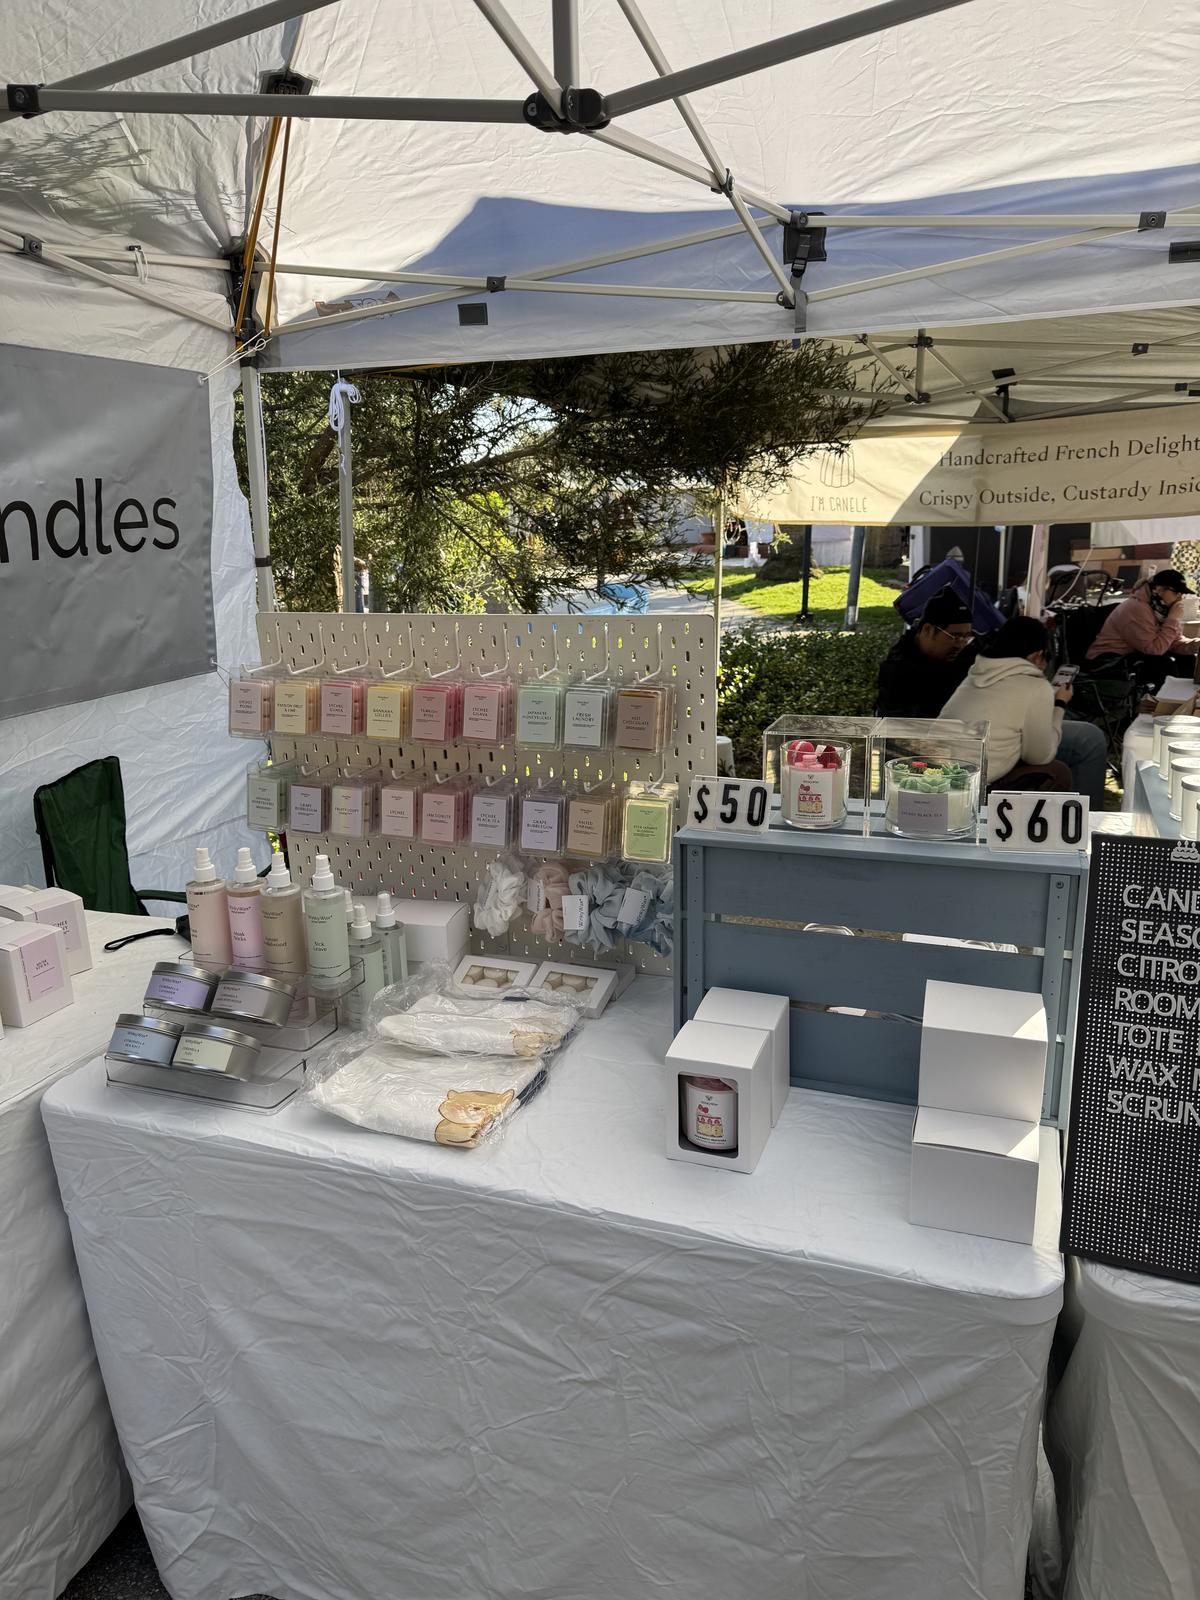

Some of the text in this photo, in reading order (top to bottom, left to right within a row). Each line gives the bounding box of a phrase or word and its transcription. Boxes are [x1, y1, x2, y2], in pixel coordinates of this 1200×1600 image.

[940, 434, 1200, 467] Handcrafted French Delight
[829, 496, 869, 513] CANELE
[919, 489, 974, 510] Crispy
[979, 486, 1056, 505] Outside,
[1063, 480, 1152, 501] Custardy
[0, 477, 180, 563] ndles
[694, 784, 768, 827] $50
[995, 798, 1083, 844] $60
[1117, 953, 1200, 985] CITRO
[1114, 987, 1200, 1021] ROOM
[1112, 1021, 1185, 1054] TOTE
[1108, 1055, 1180, 1088] WAX
